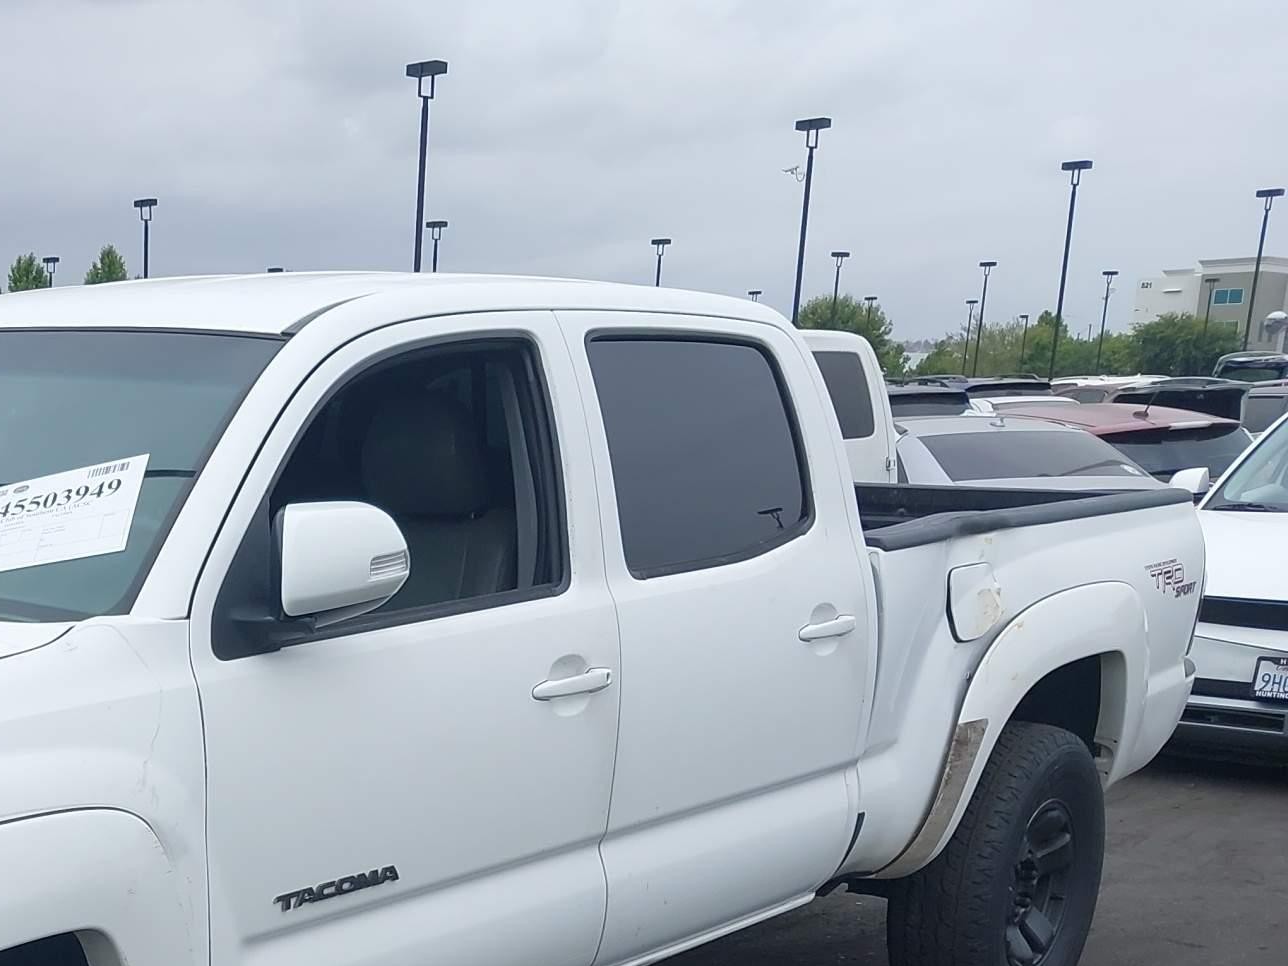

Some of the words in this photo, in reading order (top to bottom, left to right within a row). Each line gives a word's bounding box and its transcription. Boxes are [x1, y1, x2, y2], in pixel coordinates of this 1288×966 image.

[1149, 562, 1185, 594] TRD
[1175, 581, 1197, 598] SPORT
[272, 864, 400, 913] TACOMA
